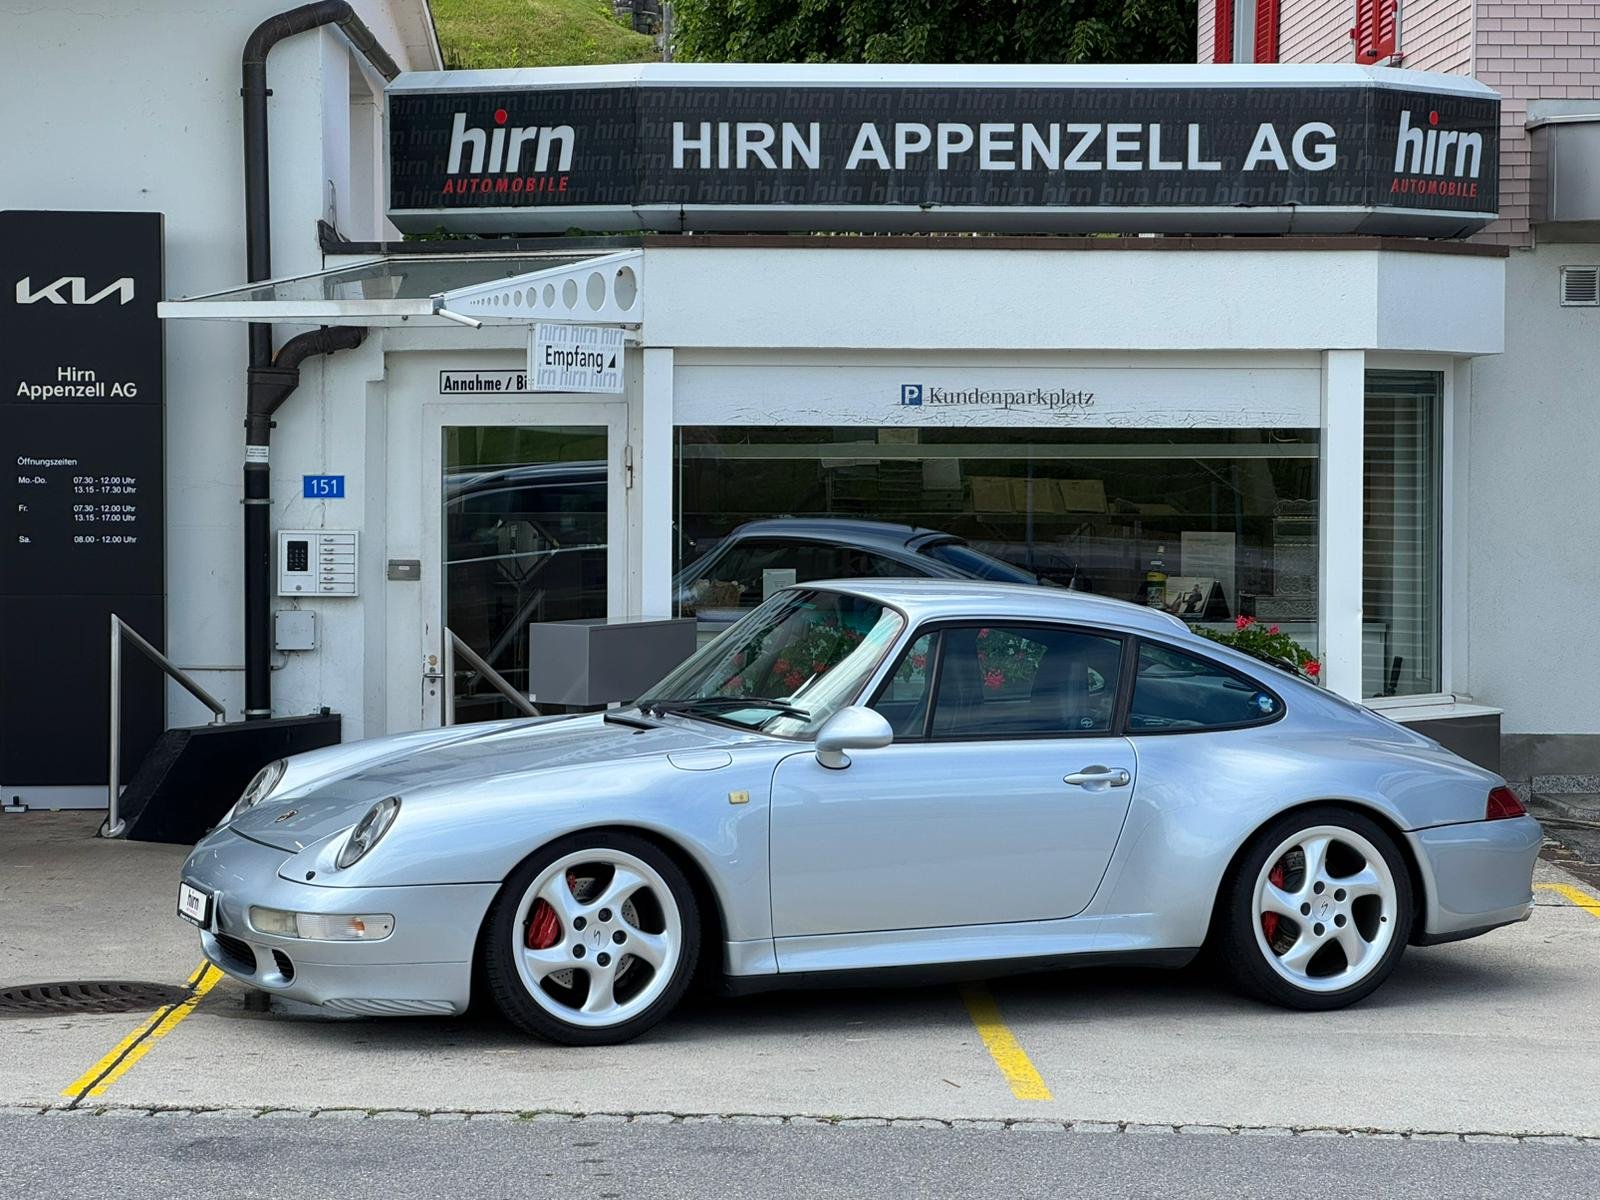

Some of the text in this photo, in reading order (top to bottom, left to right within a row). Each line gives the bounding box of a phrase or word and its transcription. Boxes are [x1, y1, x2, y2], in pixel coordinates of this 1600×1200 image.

[446, 108, 576, 176] hirn
[673, 121, 1337, 172] HIRN APPENZELL AG
[1394, 110, 1483, 178] hirn
[442, 176, 569, 194] AUTOMOBILE
[1391, 178, 1477, 197] AUTOMOBILE
[16, 276, 135, 305] KIA
[545, 345, 604, 374] Empfang
[57, 366, 96, 381] Hirn
[17, 382, 137, 400] Appenzell AG
[444, 375, 527, 391] Annahme / Bi
[903, 385, 1095, 409] P Kundenparkplatz
[17, 456, 77, 467] Öffnungszeiten
[18, 476, 47, 484] Mo.-Do.
[73, 476, 94, 484] 07.30
[100, 476, 121, 484] 12.00
[122, 476, 136, 484] Uhr
[311, 479, 338, 495] 151
[74, 486, 95, 494] 13.15
[101, 486, 122, 494] 17.30
[123, 486, 137, 494] Uhr
[18, 504, 28, 512] Fr.
[73, 504, 94, 512] 07.30
[100, 504, 121, 512] 12.00
[122, 504, 136, 512] Uhr
[74, 514, 95, 522] 13.15
[101, 514, 121, 522] 17.00
[122, 514, 136, 522] Uhr
